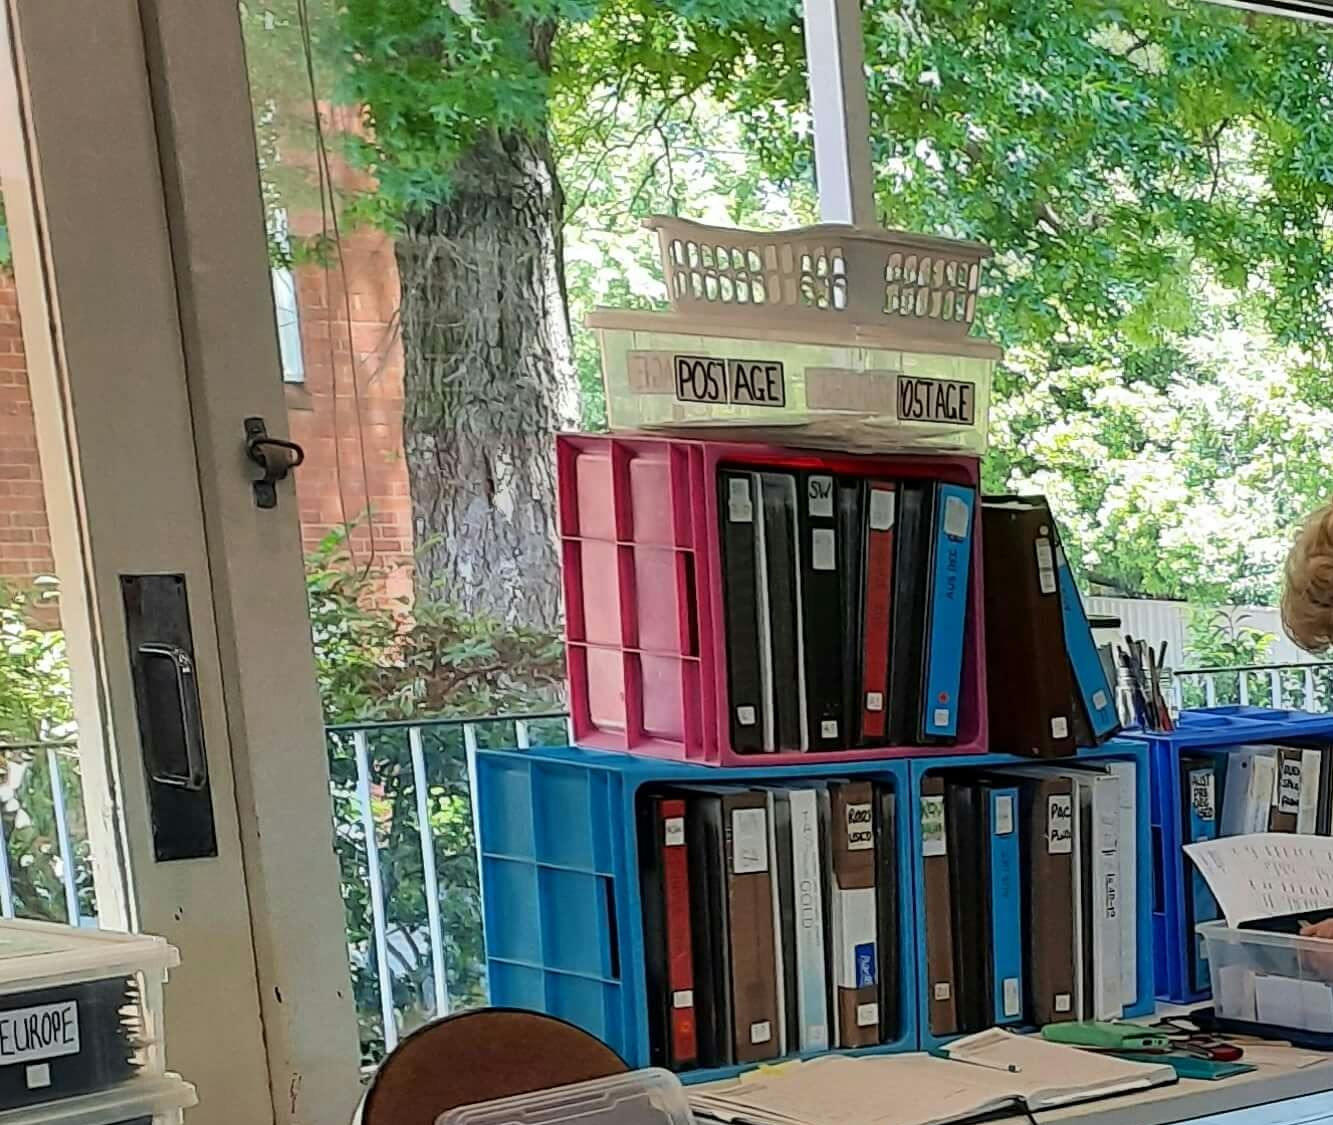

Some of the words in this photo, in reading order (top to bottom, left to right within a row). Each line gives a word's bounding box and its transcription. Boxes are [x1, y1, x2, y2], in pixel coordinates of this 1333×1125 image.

[679, 359, 780, 401] POSTAGE
[900, 379, 969, 421] OSTAGE
[0, 1006, 75, 1055] EUROPE
